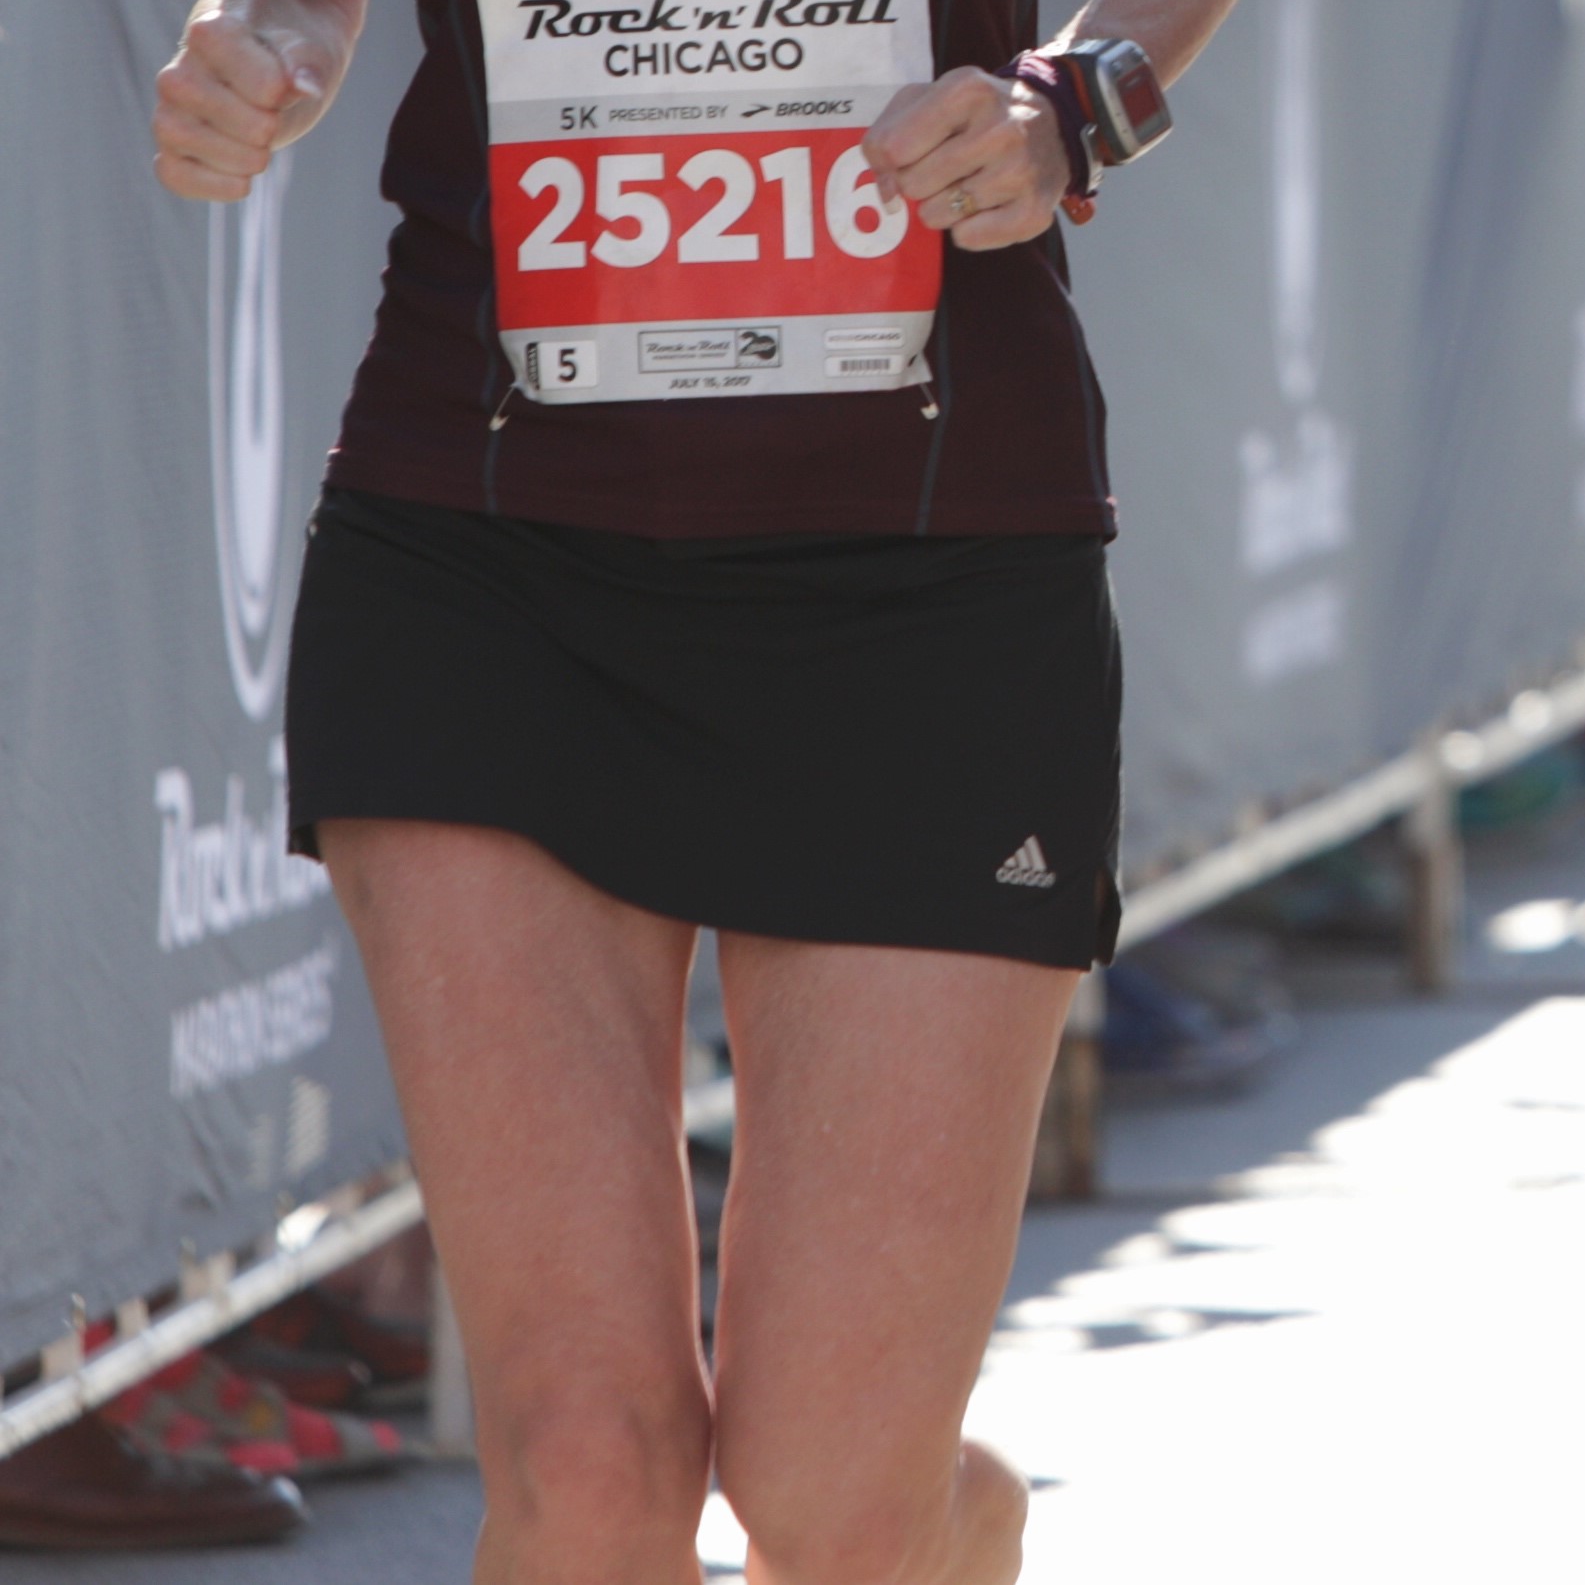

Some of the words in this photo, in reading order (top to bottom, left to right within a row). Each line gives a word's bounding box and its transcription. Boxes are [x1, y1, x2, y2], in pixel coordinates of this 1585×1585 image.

[604, 37, 805, 77] CHICAGO
[560, 105, 599, 131] 5K
[609, 106, 703, 124] PRESENTED
[706, 104, 729, 119] BY
[774, 99, 853, 117] BROOKS
[517, 144, 909, 272] 25216
[558, 347, 577, 383] 5
[996, 867, 1056, 887] adidas
